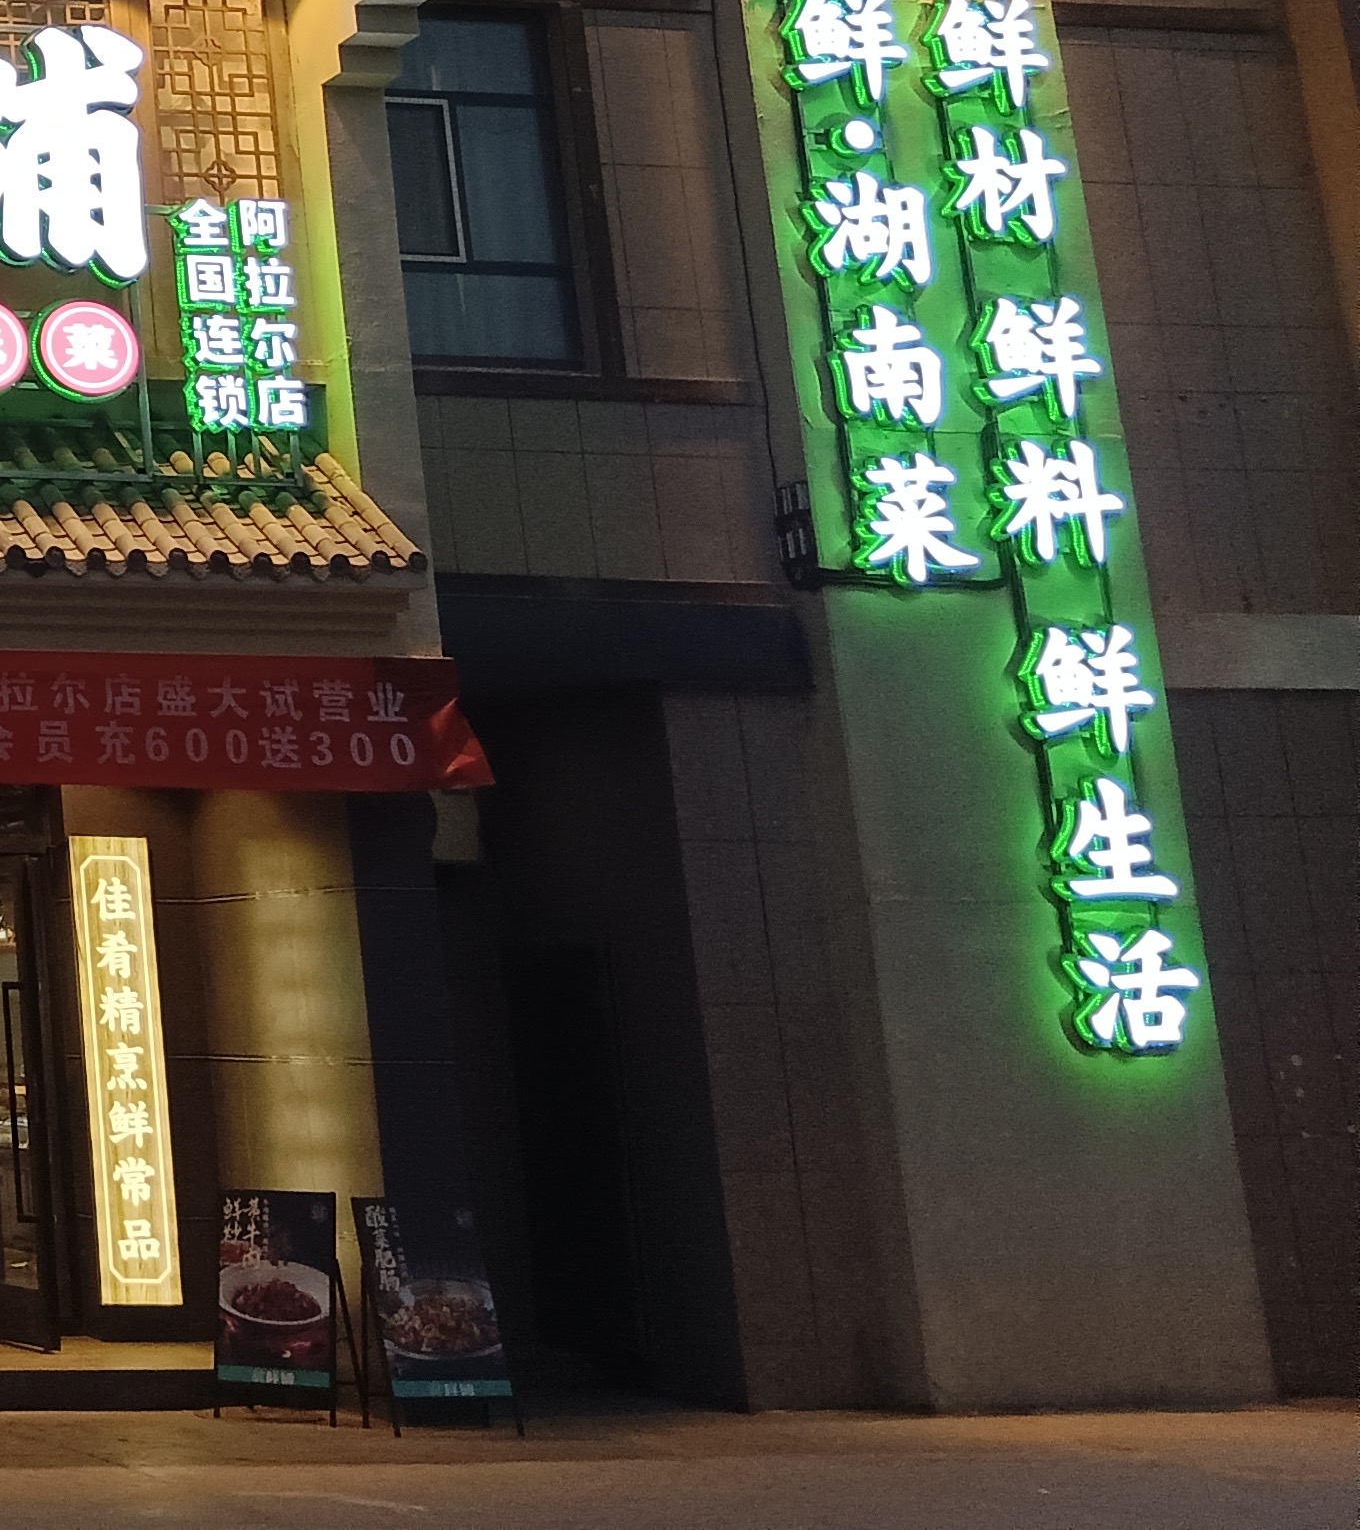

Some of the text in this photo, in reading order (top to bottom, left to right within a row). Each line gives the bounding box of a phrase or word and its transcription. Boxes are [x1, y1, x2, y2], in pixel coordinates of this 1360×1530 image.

[179, 198, 250, 427] 全国连锁
[238, 199, 309, 426] 阿拉尔店
[90, 877, 161, 1261] 佳肴精烹鲜常品
